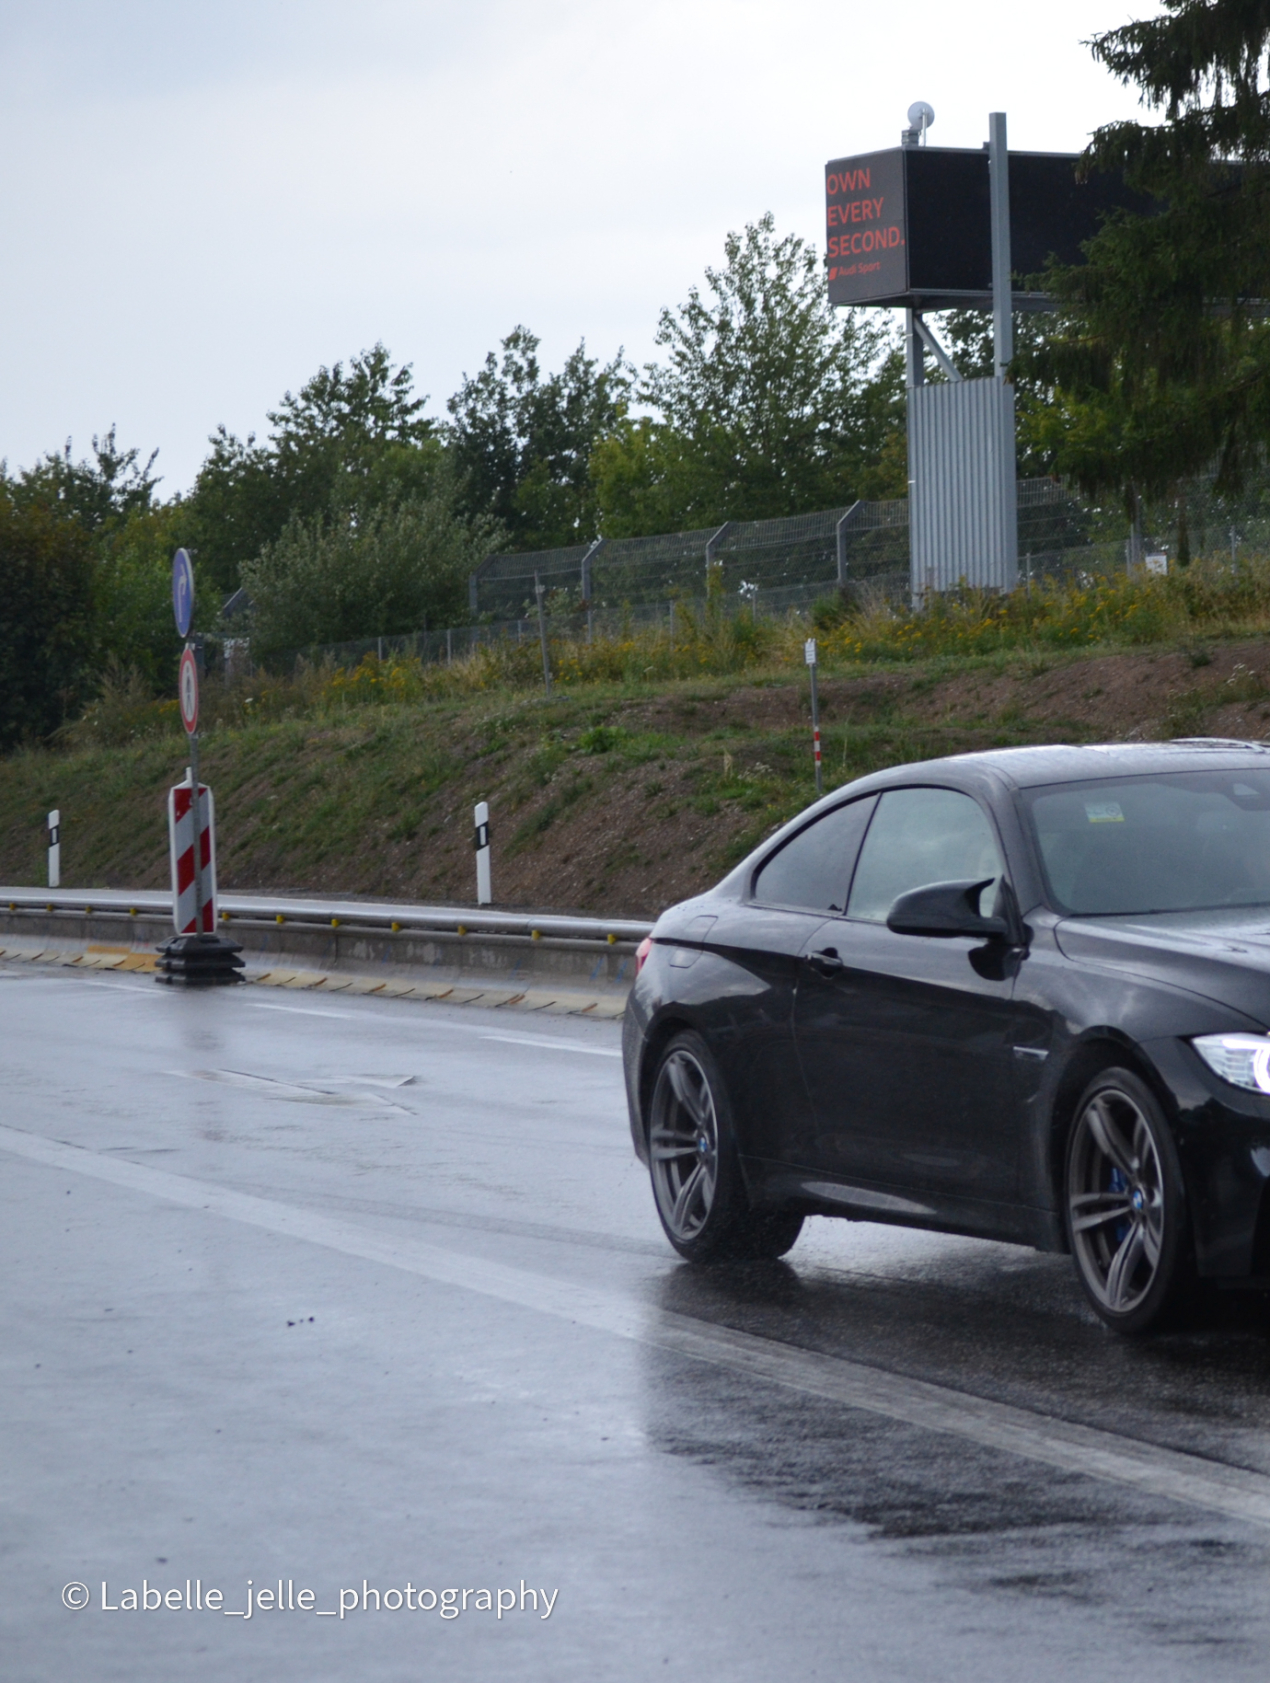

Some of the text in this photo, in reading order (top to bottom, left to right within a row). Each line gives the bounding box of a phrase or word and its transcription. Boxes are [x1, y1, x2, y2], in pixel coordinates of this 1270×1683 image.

[826, 167, 871, 195] OWN
[827, 197, 884, 227] EVERY
[828, 226, 906, 258] SECOND.
[838, 261, 881, 276] Audi Sport
